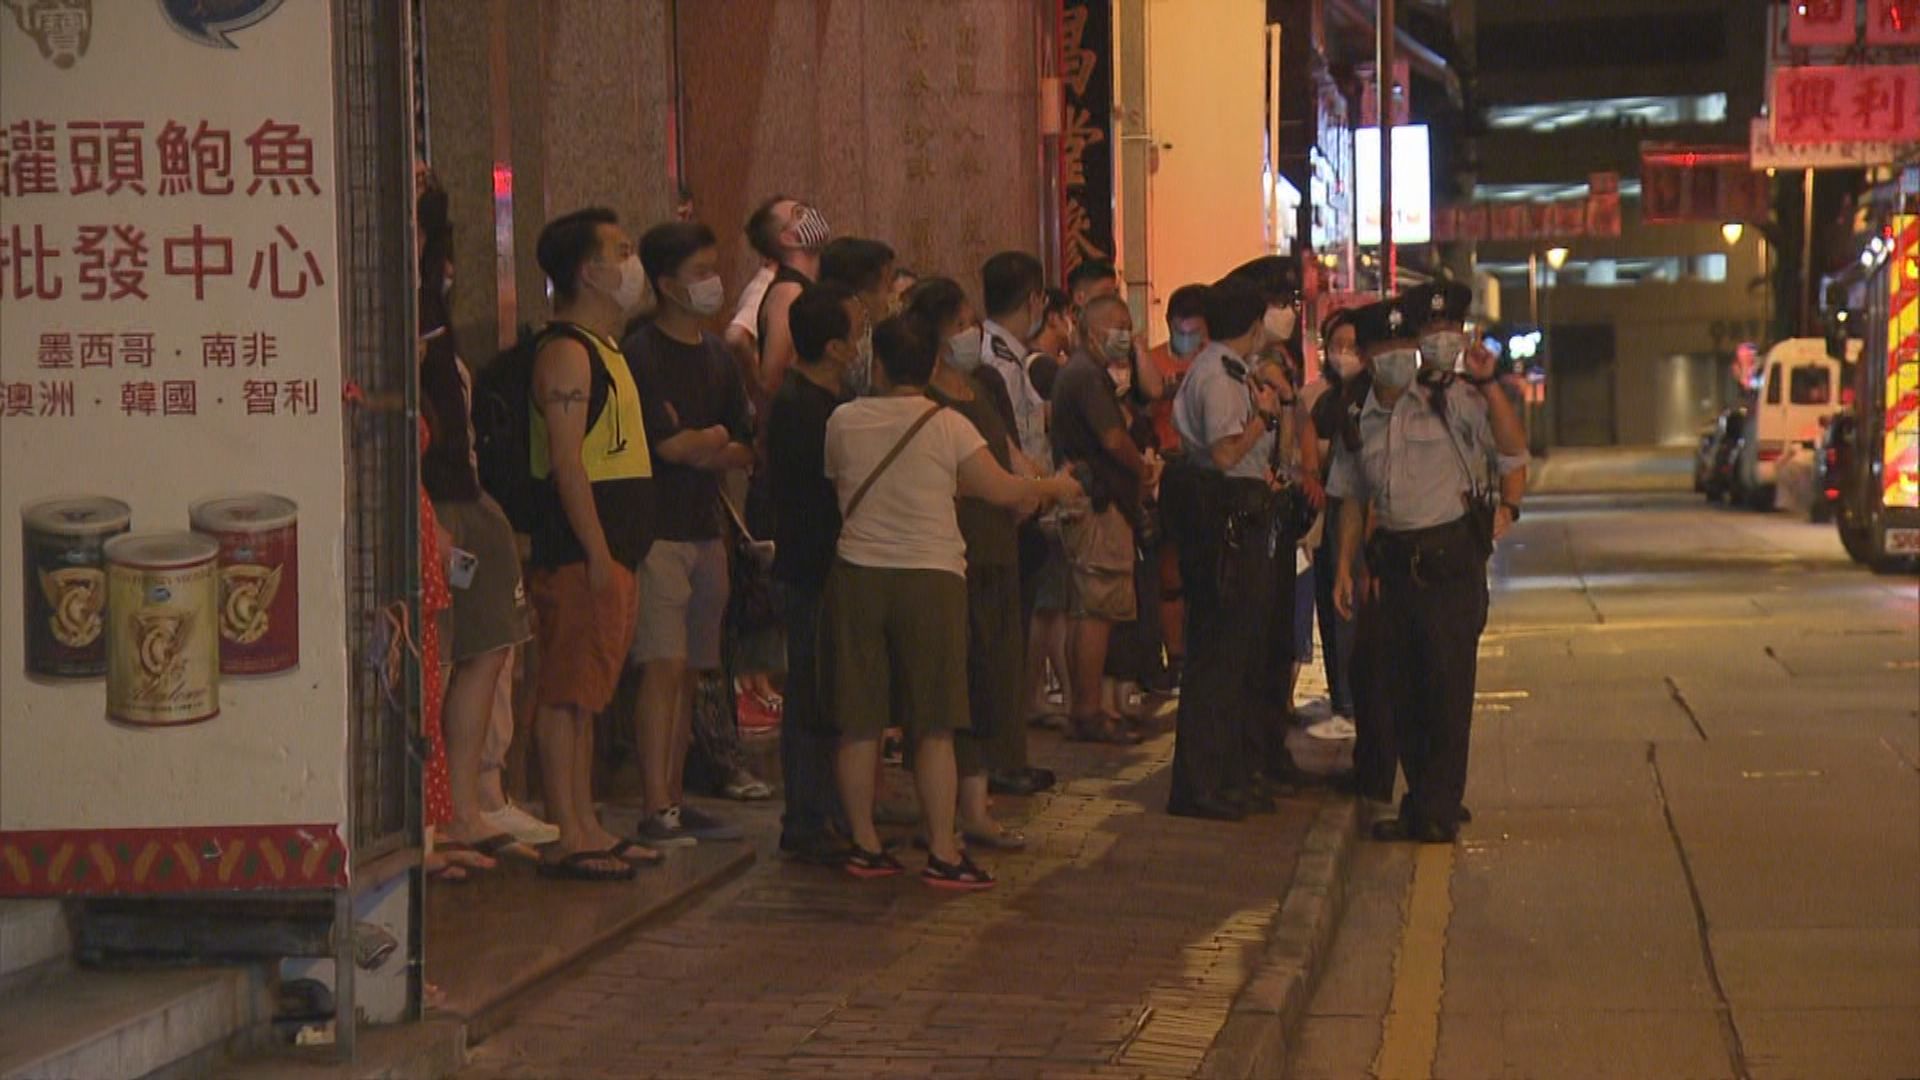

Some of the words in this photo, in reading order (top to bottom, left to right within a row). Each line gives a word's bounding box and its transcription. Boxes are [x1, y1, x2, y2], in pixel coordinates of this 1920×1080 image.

[0, 118, 322, 198] 罐頭鮑魚
[0, 223, 325, 301] 批發中心
